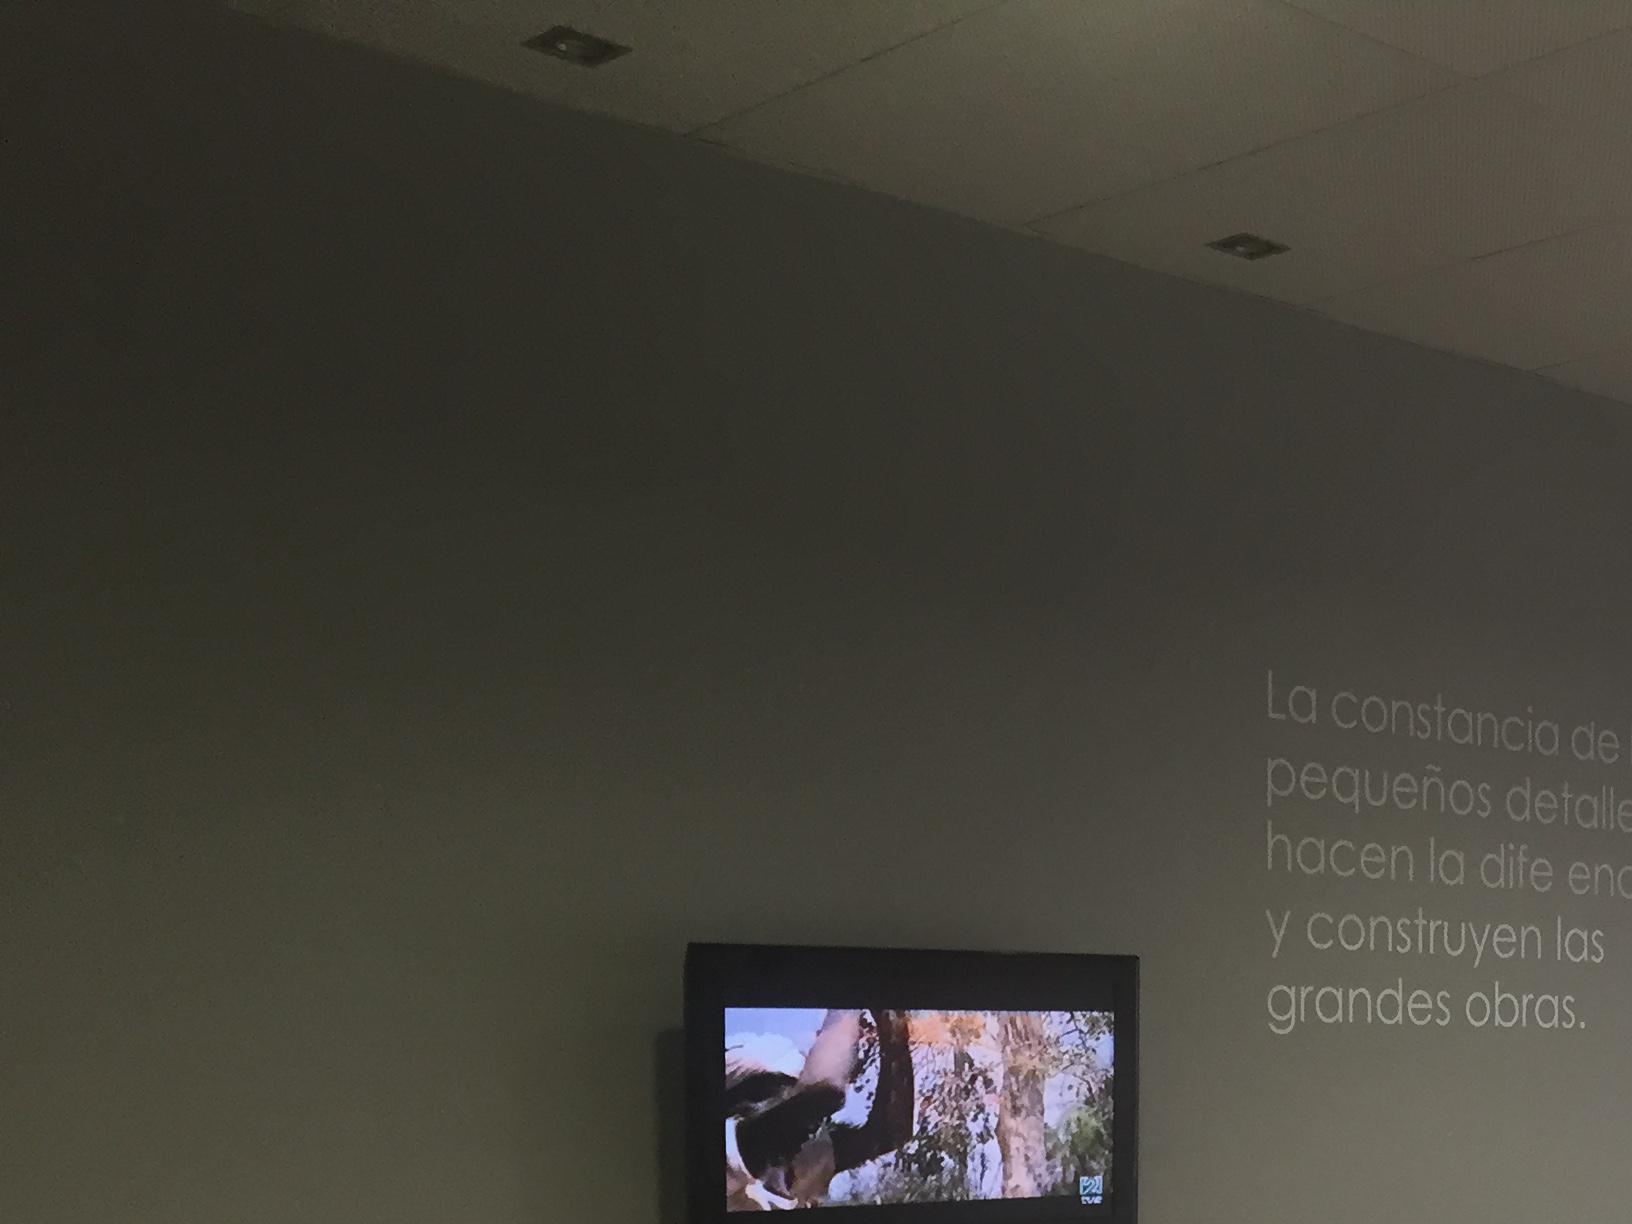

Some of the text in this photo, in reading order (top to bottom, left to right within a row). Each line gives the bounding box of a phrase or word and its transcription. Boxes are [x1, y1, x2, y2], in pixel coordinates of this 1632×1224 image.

[1267, 669, 1317, 724] La
[1331, 690, 1560, 756] constancia
[1570, 720, 1620, 764] de
[1266, 756, 1492, 819] pequeños
[1266, 819, 1415, 881] hacen
[1429, 835, 1465, 886] la
[1265, 906, 1605, 969] y construyen las
[1266, 976, 1587, 1035] grandes obras.
